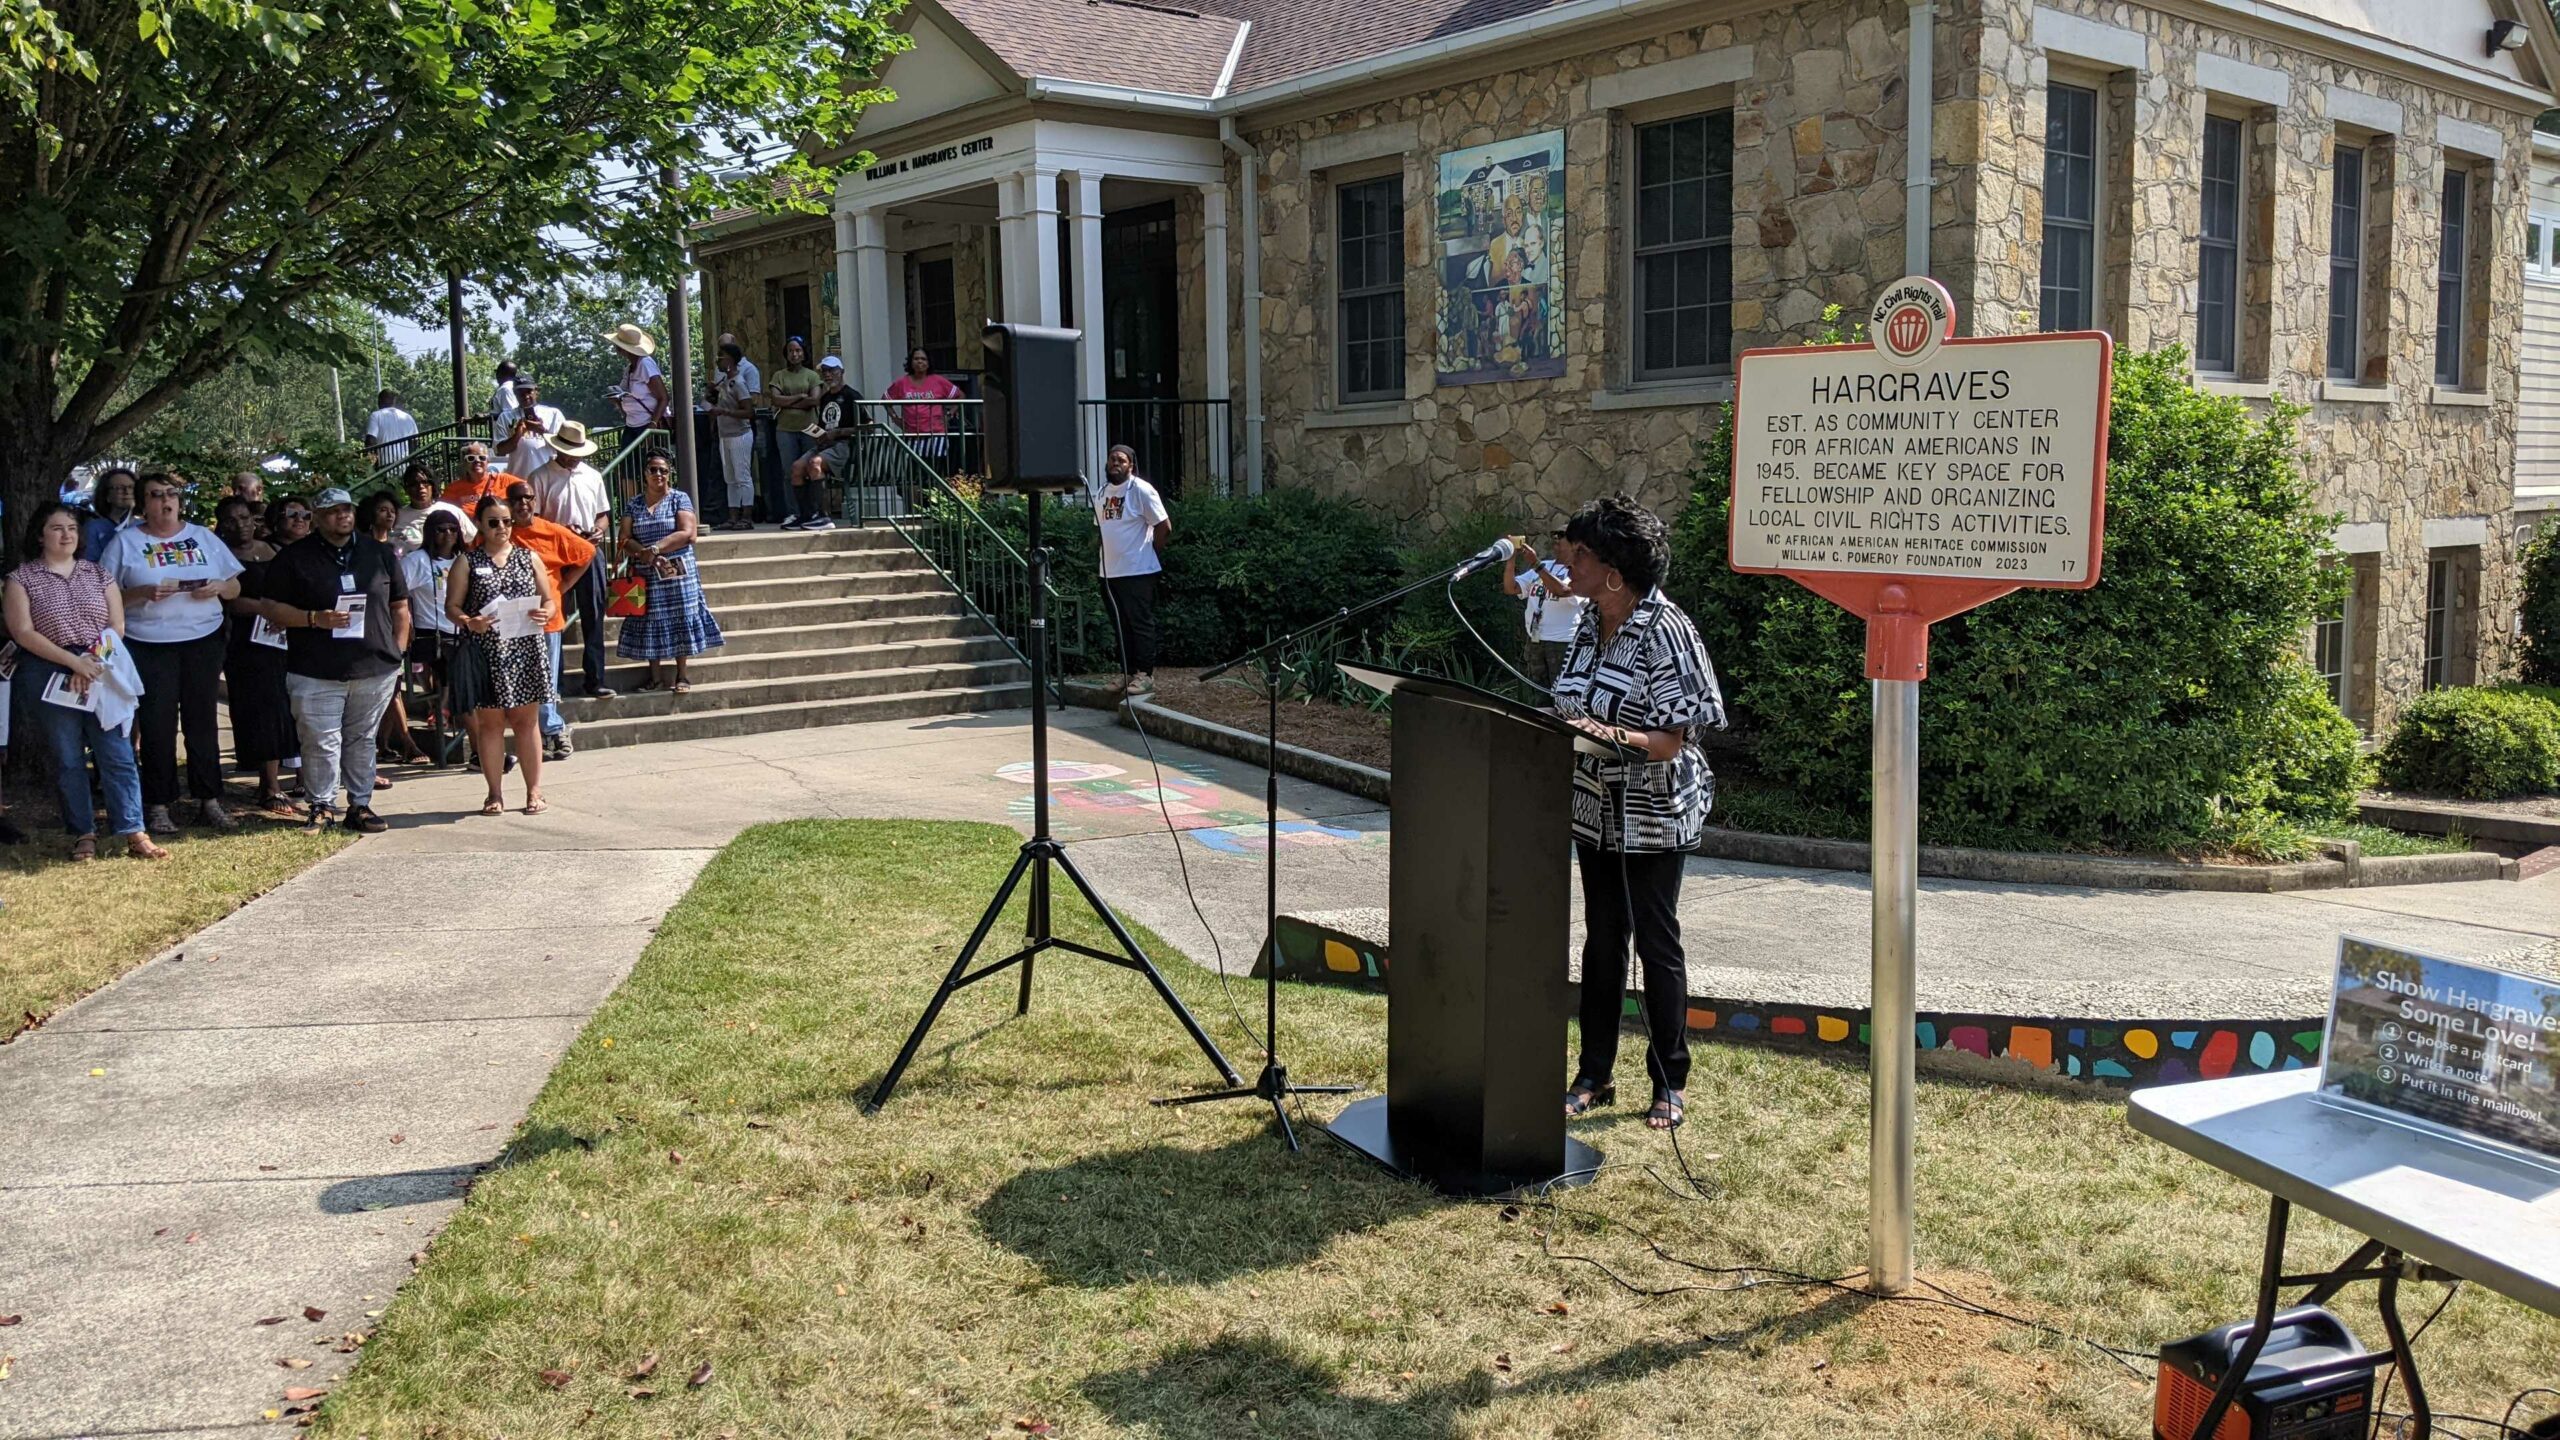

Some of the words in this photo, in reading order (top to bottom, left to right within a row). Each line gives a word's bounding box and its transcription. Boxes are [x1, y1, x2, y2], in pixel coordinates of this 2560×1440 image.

[866, 163, 896, 181] WILLIAM
[912, 147, 957, 169] HARGRAVES
[961, 136, 994, 156] CENTER
[1873, 307, 1887, 324] NC
[1884, 289, 1904, 309] Civil
[1904, 286, 1932, 304] Rights
[1930, 297, 1946, 321] Trail
[1813, 370, 2009, 404] HARGRAVES
[1768, 415, 1806, 432] EST.
[1815, 415, 1838, 432] AS
[1847, 411, 1959, 430] COMMUNITY
[1974, 409, 2058, 429] CENTER
[1773, 439, 1805, 456] FOR
[1816, 437, 1893, 455] AFRICAN
[1905, 437, 2018, 455] AMERICANS
[2032, 436, 2050, 455] IN
[1757, 462, 1799, 479] 1945.
[1814, 462, 1886, 479] BECAME
[1898, 463, 1936, 480] KEY
[1947, 463, 2010, 481] SPACE
[2023, 464, 2064, 481] FOR
[1762, 486, 1874, 504] FELLOWSHIP
[1884, 488, 1921, 505] AND
[1932, 488, 2054, 508] ORGANIZING
[1750, 510, 1805, 526] LOCAL
[1815, 511, 1861, 528] CIVIL
[1871, 512, 1939, 531] RIGHTS
[1952, 514, 2070, 535] ACTIVITIES.
[1766, 533, 1781, 545] NC
[1786, 535, 1833, 547] AFRICAN
[1840, 536, 1898, 548] AMERICAN
[1905, 538, 1963, 550] HERITAGE
[1971, 540, 2046, 553] COMMISSION
[1781, 549, 1826, 562] WILLIAM
[1848, 552, 1898, 564] POMEROY
[1907, 554, 1981, 567] FOUNDATION
[1996, 558, 2028, 570] 2023
[2062, 560, 2075, 572] 17
[2375, 970, 2440, 1001] Show
[2399, 1000, 2465, 1033] Some
[2472, 1017, 2537, 1052] Love!
[2407, 1030, 2458, 1053] Choose
[2461, 1046, 2469, 1056] a
[2472, 1049, 2533, 1073] postcard
[2404, 1051, 2443, 1071] Write
[2445, 1065, 2454, 1075] a
[2457, 1068, 2488, 1084] note
[2401, 1073, 2425, 1088] Put
[2428, 1080, 2438, 1093] it
[2440, 1084, 2453, 1097] in
[2457, 1090, 2480, 1105] the
[2482, 1098, 2543, 1123] mailbox!
